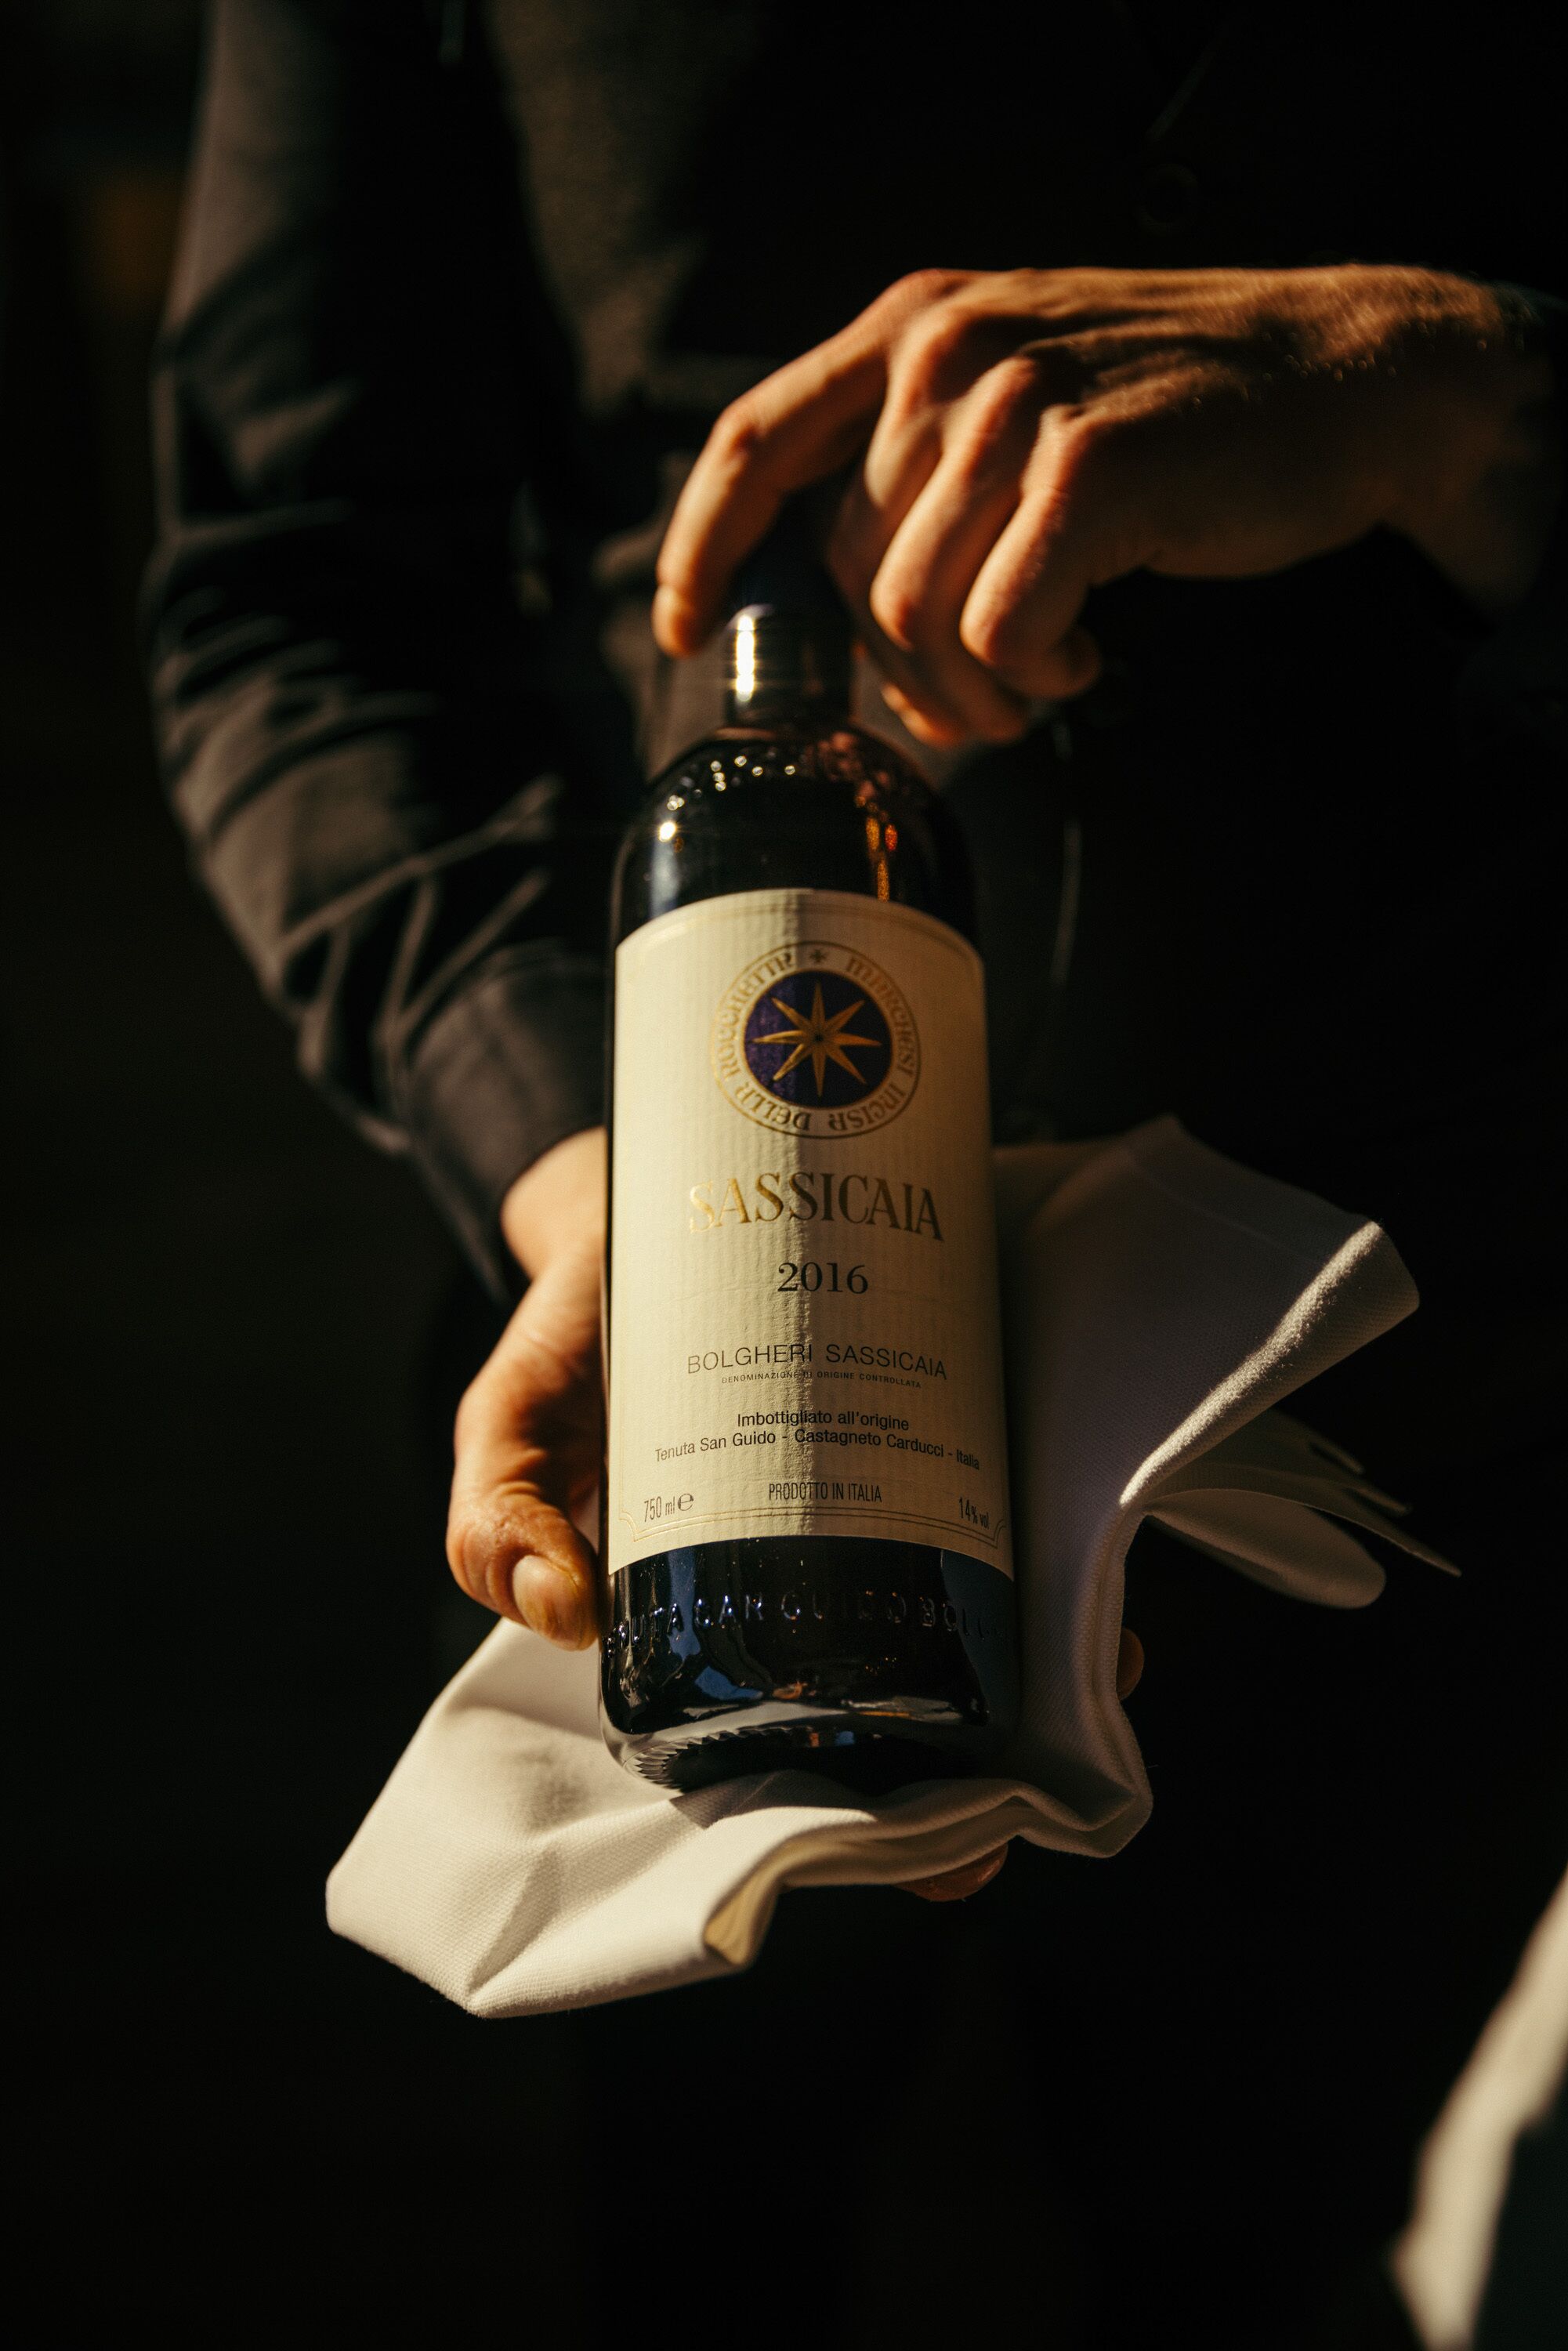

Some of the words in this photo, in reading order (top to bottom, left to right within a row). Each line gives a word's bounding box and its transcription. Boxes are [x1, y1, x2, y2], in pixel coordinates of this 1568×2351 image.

[689, 1172, 944, 1242] SASSICAIA
[777, 1262, 868, 1294] 2016
[688, 1343, 813, 1374] BOLGHERI
[825, 1343, 947, 1380] SASSICAIA
[722, 1371, 798, 1384] DENOMINAZIONE
[817, 1371, 855, 1380] ORIGINE
[859, 1373, 922, 1389] CONTROLLATA
[737, 1410, 832, 1427] Imbottigliato
[838, 1411, 909, 1430] all'origine
[656, 1441, 696, 1462] Tenuta
[700, 1437, 726, 1451] San
[733, 1430, 776, 1447] Guido
[795, 1429, 881, 1446] Castagneto
[886, 1433, 944, 1458] Carducci
[957, 1449, 980, 1470] Italia
[769, 1481, 828, 1501] PRODOTTO
[832, 1482, 844, 1500] IN
[848, 1483, 882, 1502] ITALIA
[643, 1495, 661, 1523] 750
[665, 1495, 675, 1516] ml
[958, 1496, 978, 1524] 14%
[980, 1511, 990, 1529] vol
